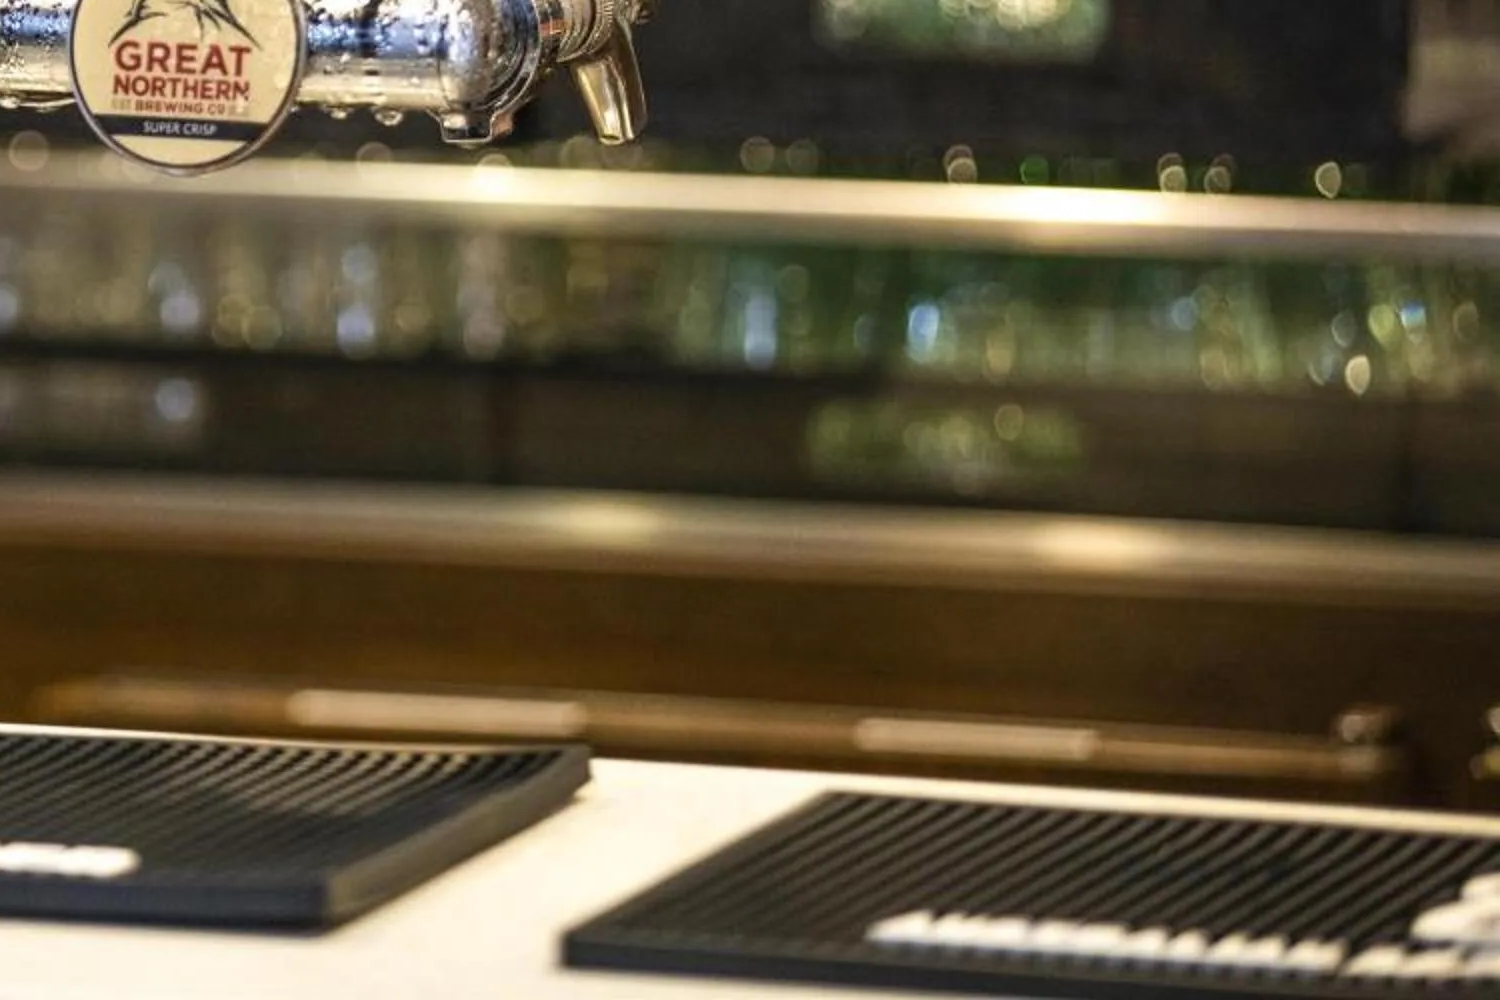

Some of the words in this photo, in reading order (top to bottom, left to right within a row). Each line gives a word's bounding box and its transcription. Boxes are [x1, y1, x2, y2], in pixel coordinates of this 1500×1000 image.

[114, 40, 253, 77] GREAT
[112, 74, 250, 101] NORTHERN
[135, 99, 204, 114] BREWING
[142, 120, 180, 134] SUPER
[182, 122, 218, 136] CRISP
